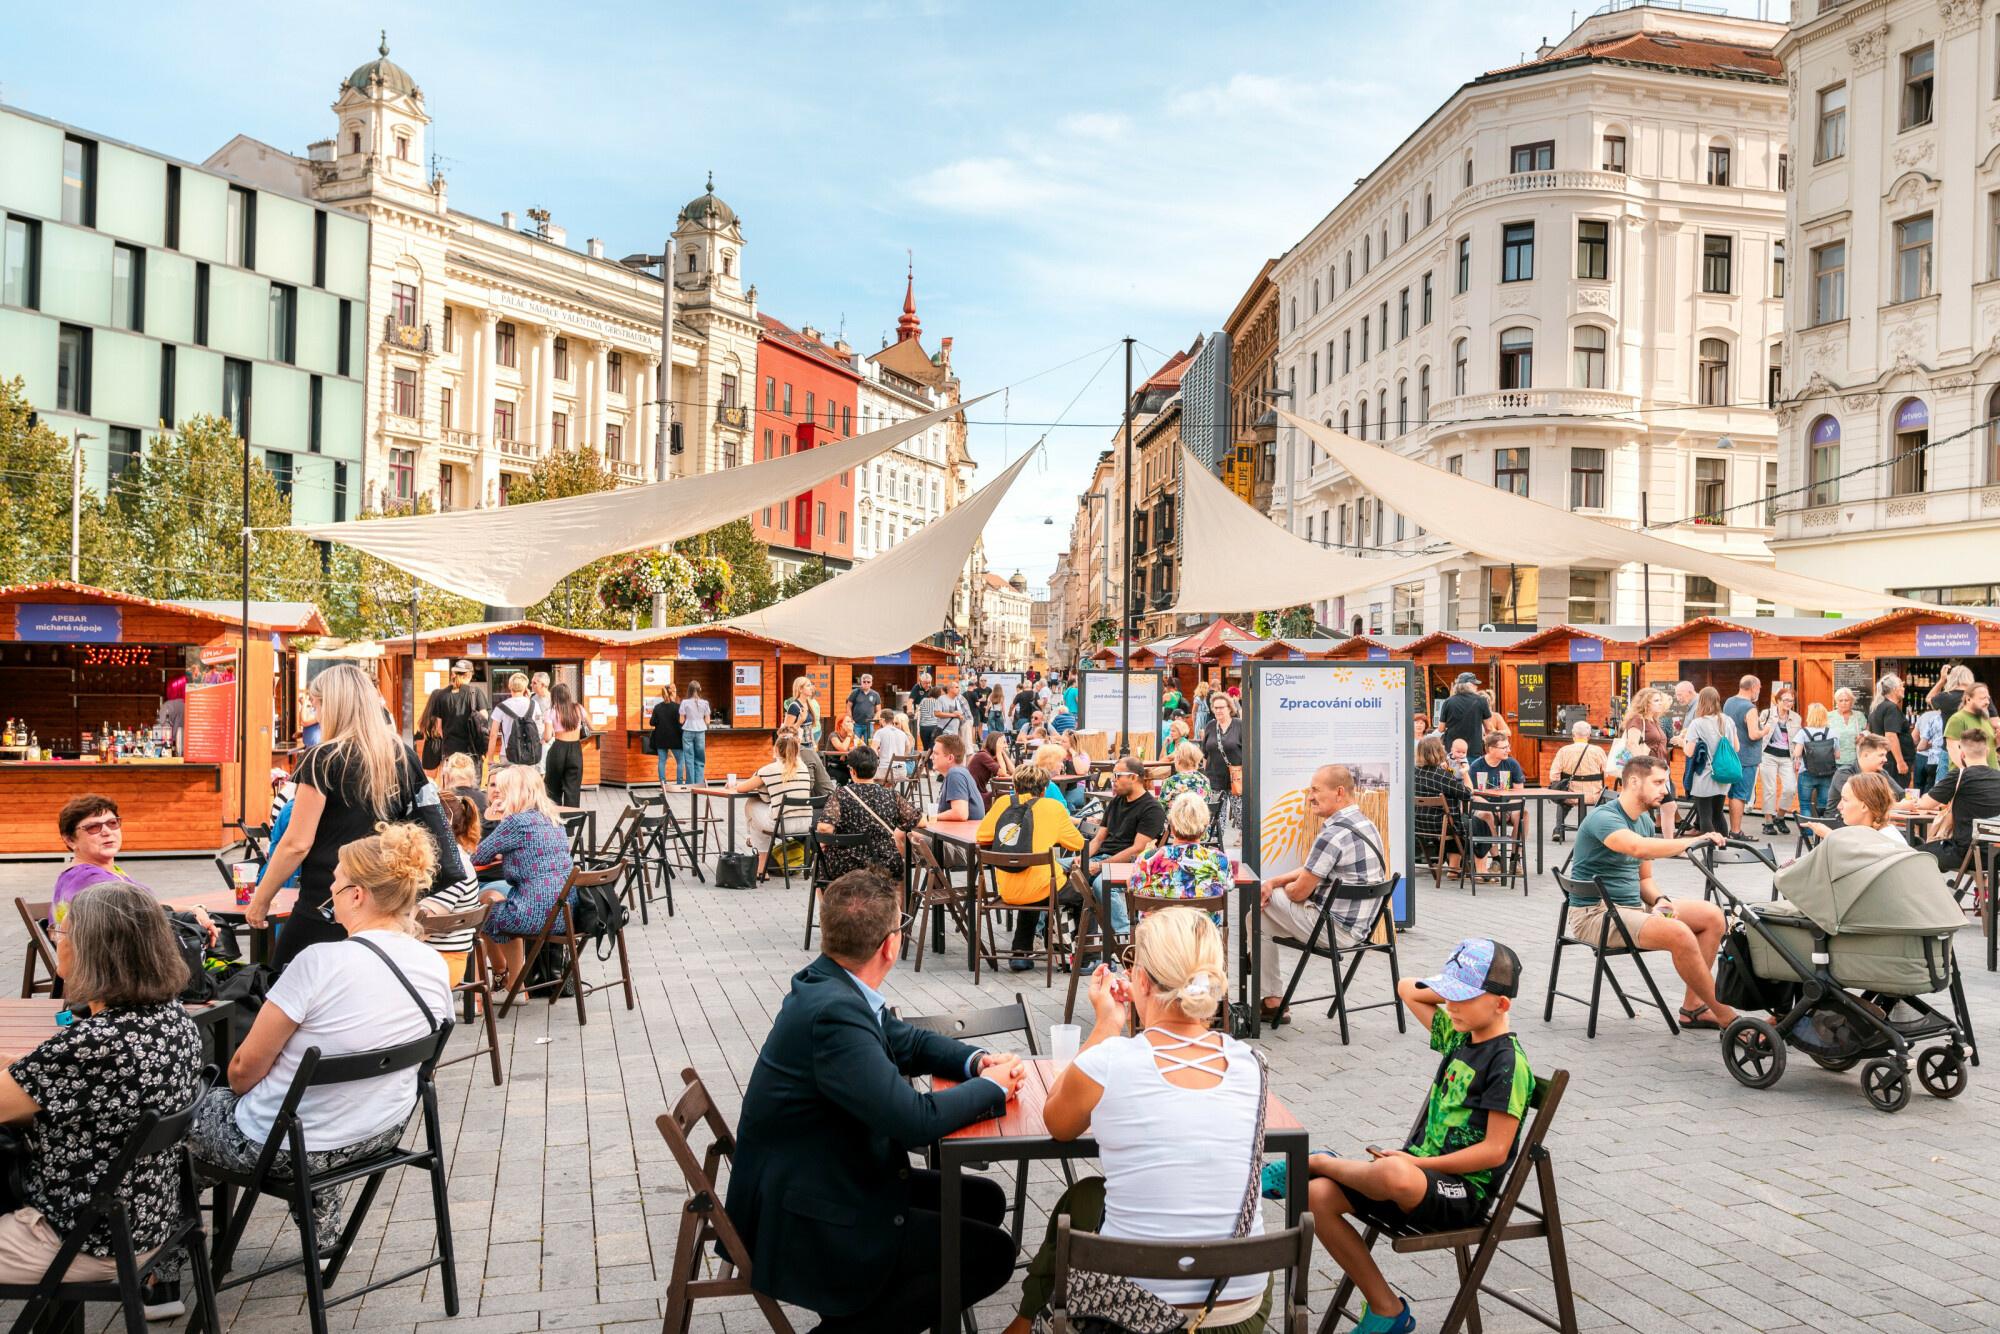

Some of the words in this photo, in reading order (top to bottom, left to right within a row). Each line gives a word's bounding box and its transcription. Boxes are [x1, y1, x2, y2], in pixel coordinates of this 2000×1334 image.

[72, 624, 102, 633] nápoje
[84, 644, 152, 667] SPRITZ
[1520, 674, 1544, 685] STERN
[1280, 697, 1352, 711] Zpracování
[1354, 697, 1383, 709] obilí
